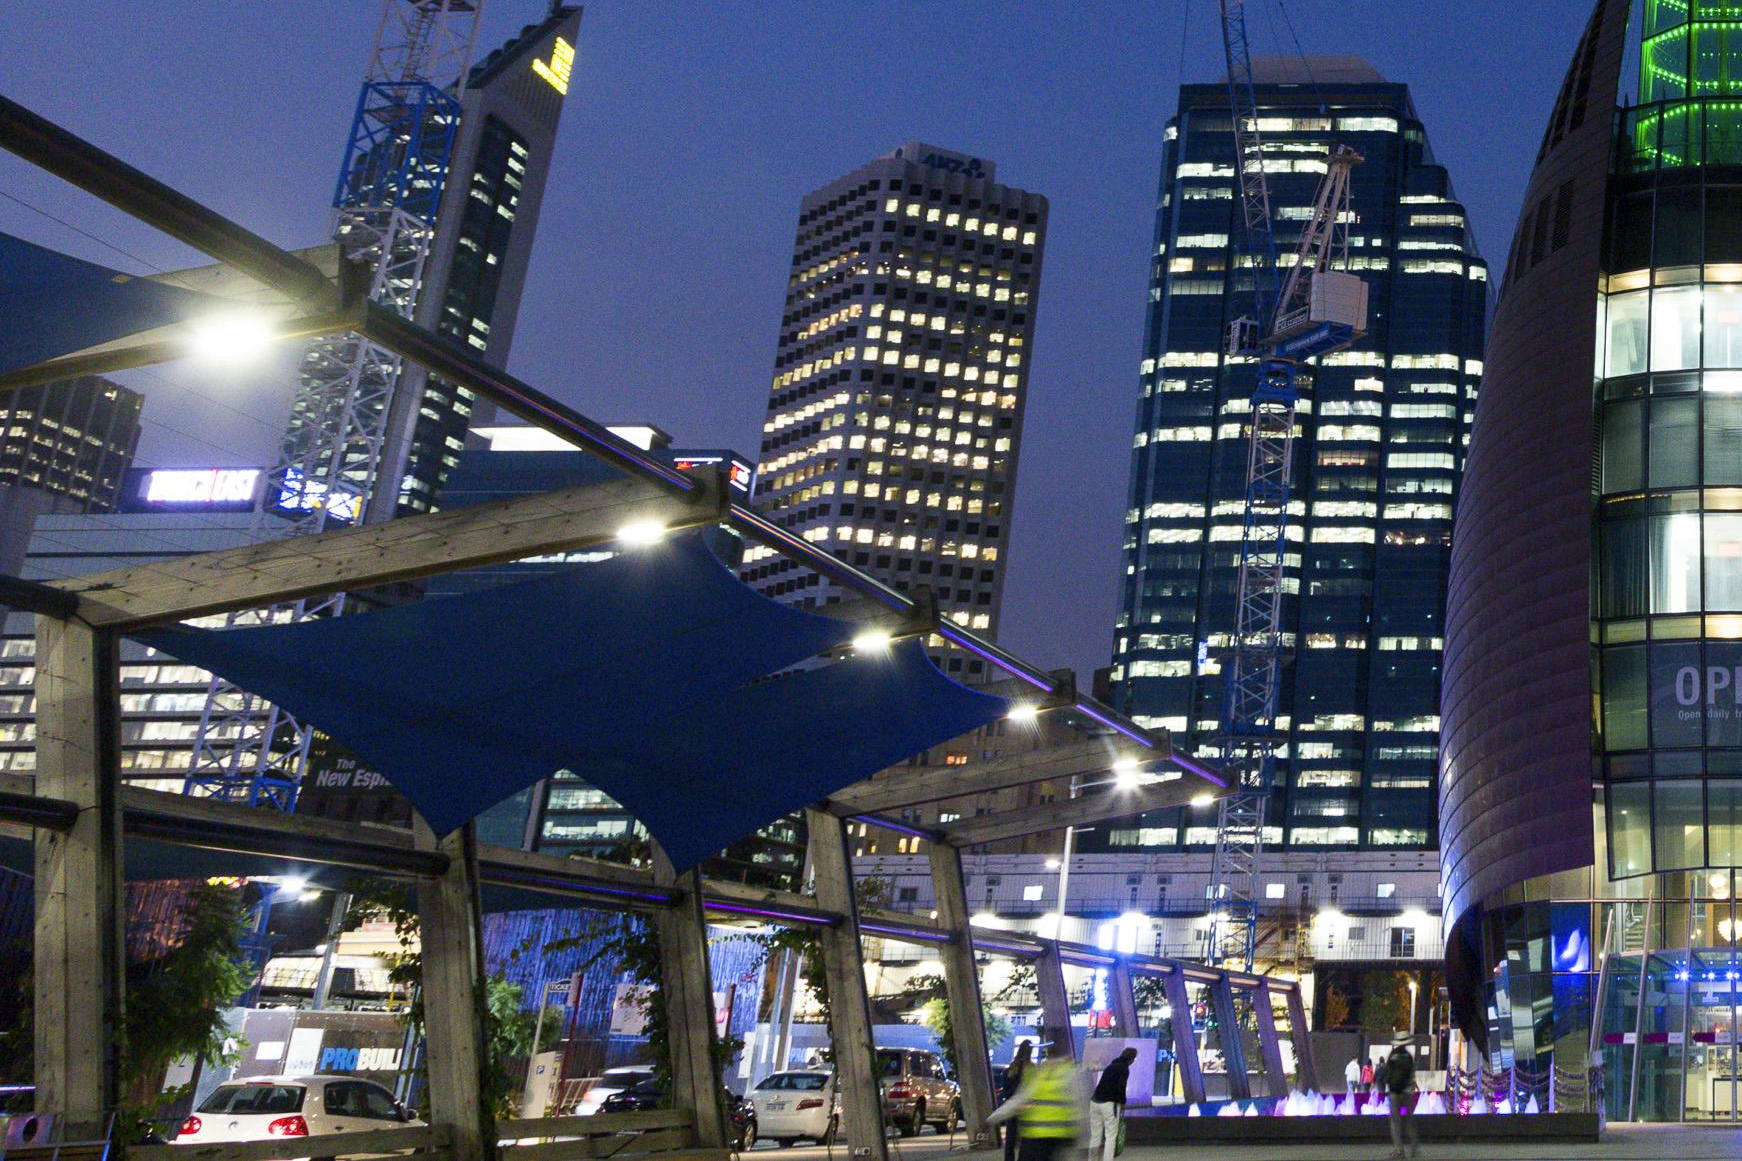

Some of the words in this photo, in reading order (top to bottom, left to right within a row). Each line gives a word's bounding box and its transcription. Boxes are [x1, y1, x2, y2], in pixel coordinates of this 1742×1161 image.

[1678, 709, 1701, 720] Open
[1706, 708, 1730, 720] daily
[336, 759, 355, 769] The
[316, 770, 351, 786] New
